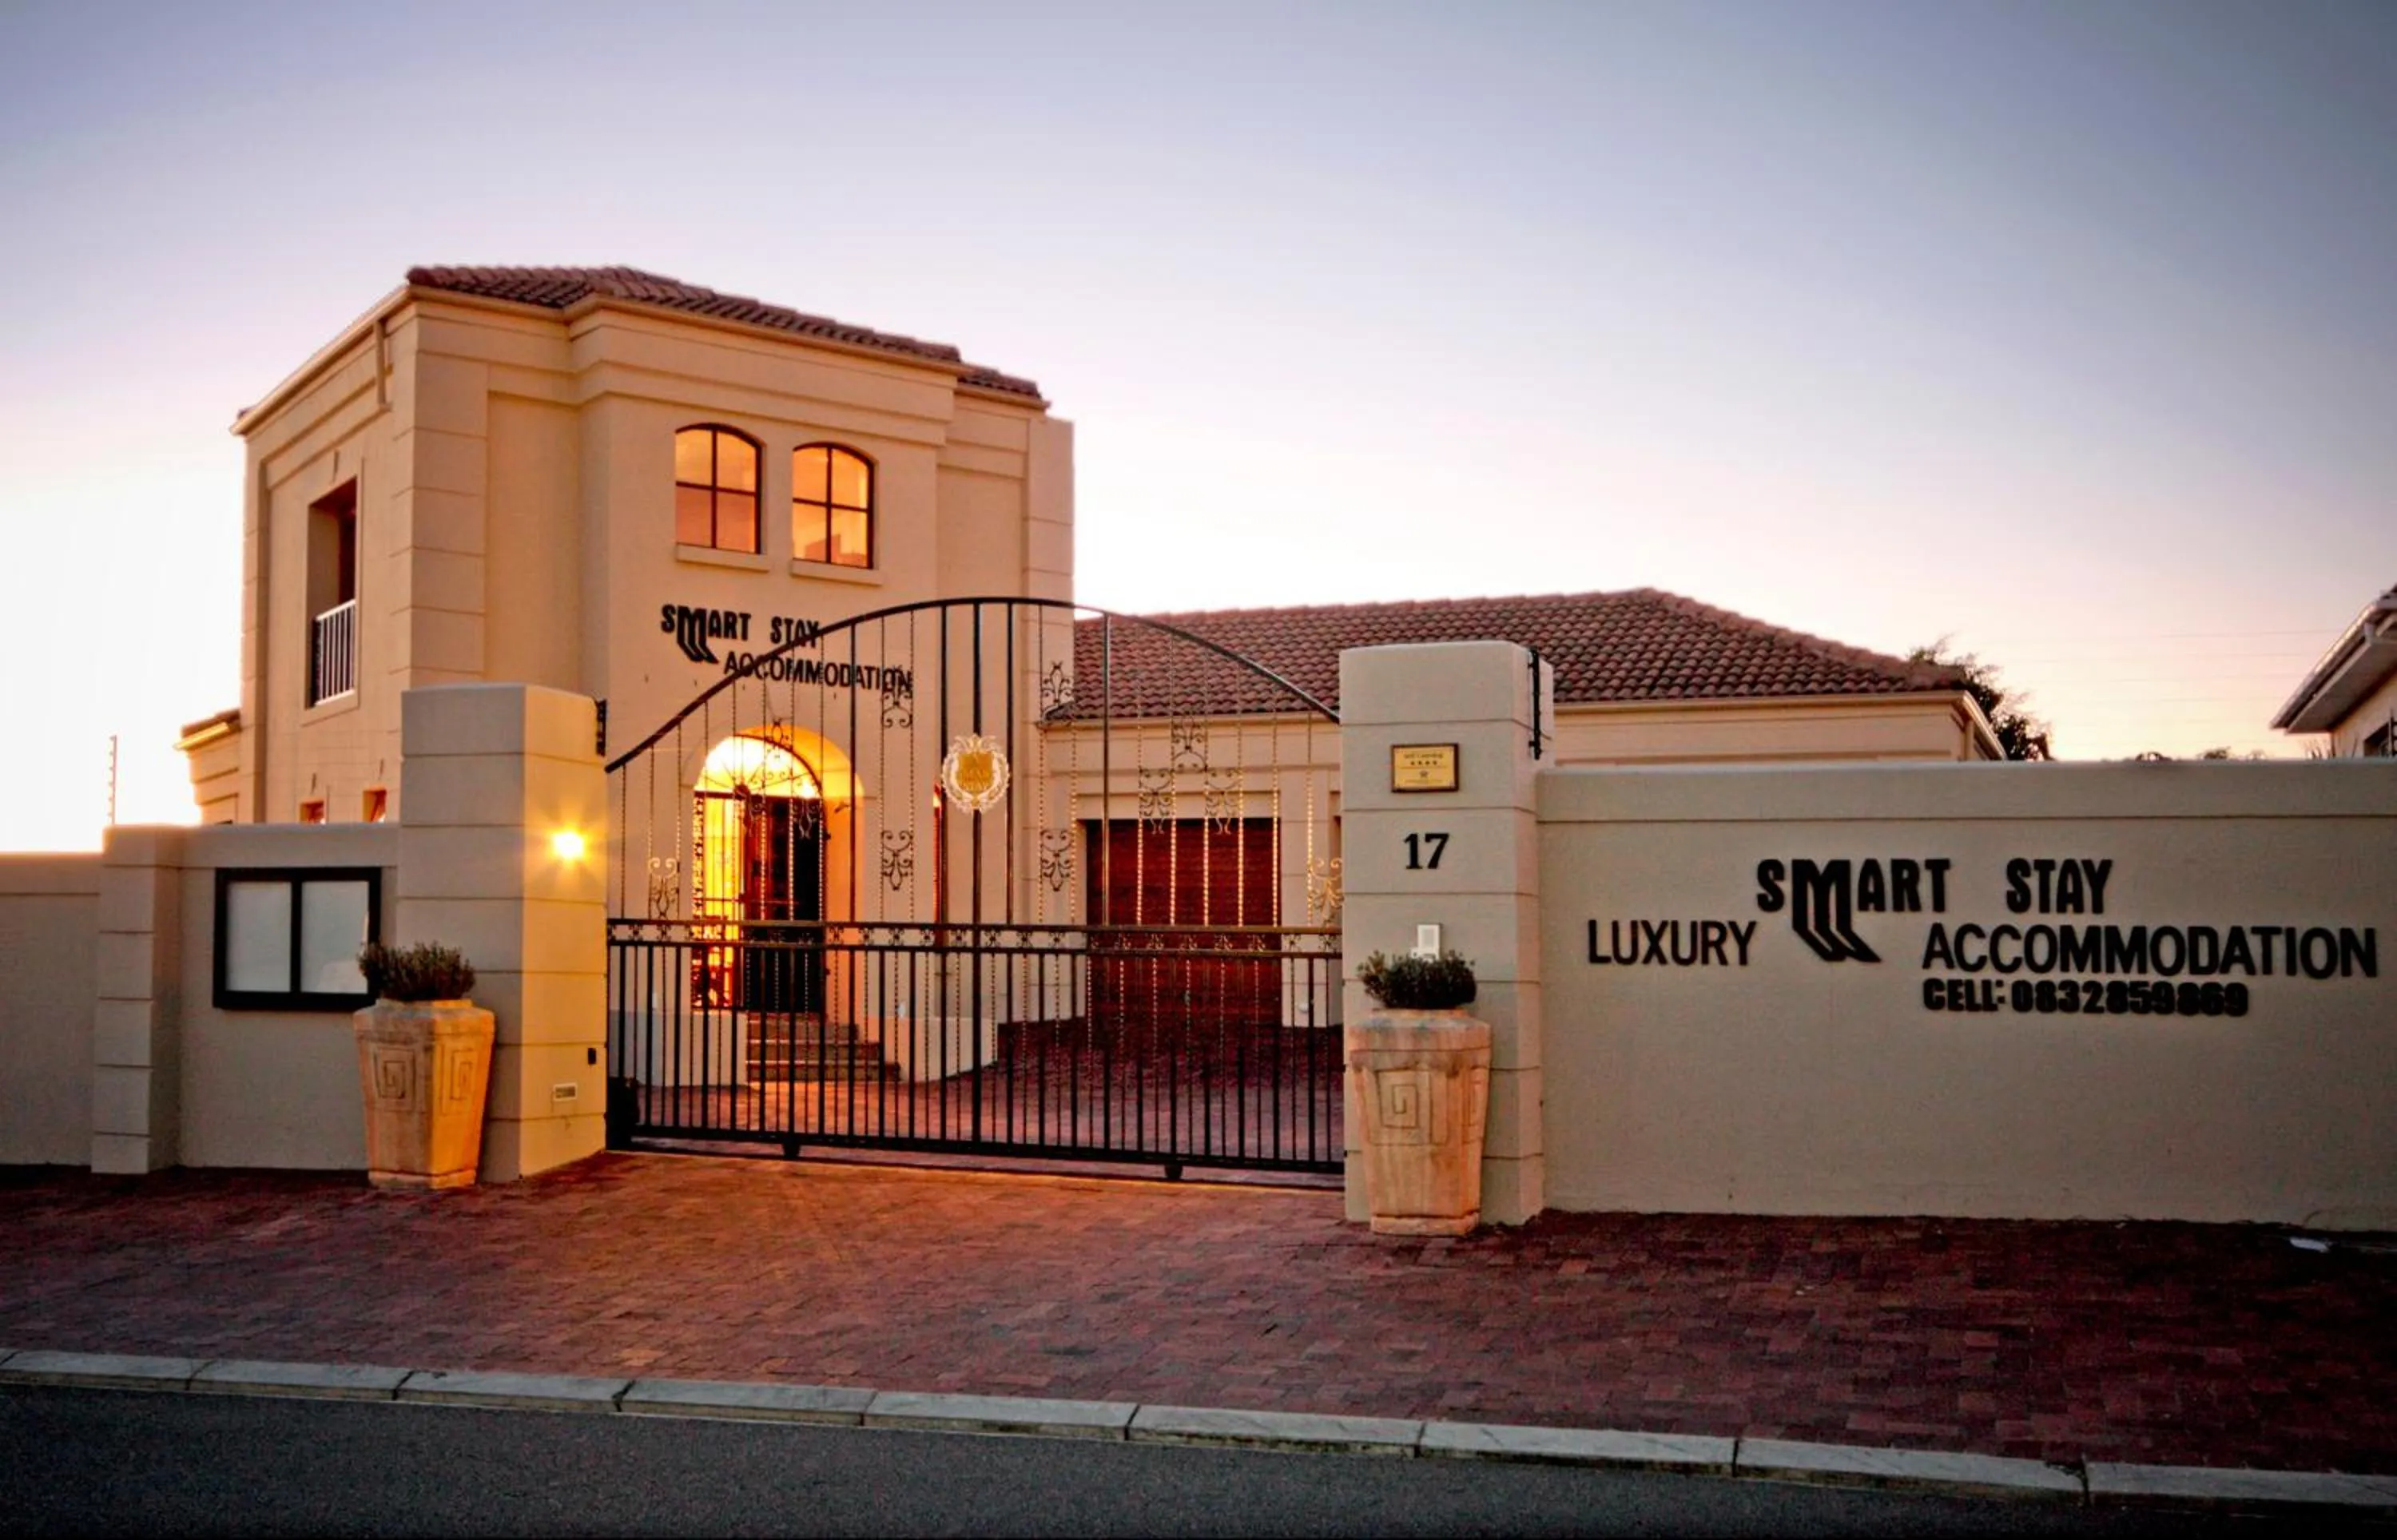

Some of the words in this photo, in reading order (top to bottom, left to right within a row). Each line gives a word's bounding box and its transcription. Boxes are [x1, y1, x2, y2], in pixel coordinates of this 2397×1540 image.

[661, 604, 751, 664] SMART
[770, 616, 819, 648] STAY
[724, 651, 912, 693] ACCOMMODATION
[1404, 832, 1449, 870] 17
[1756, 857, 1952, 963] SMART
[2005, 857, 2113, 915] STAY
[1588, 919, 1757, 966] LUXURY
[1922, 922, 2379, 979] ACCOMMODATION
[1922, 978, 2006, 1013] CELL:
